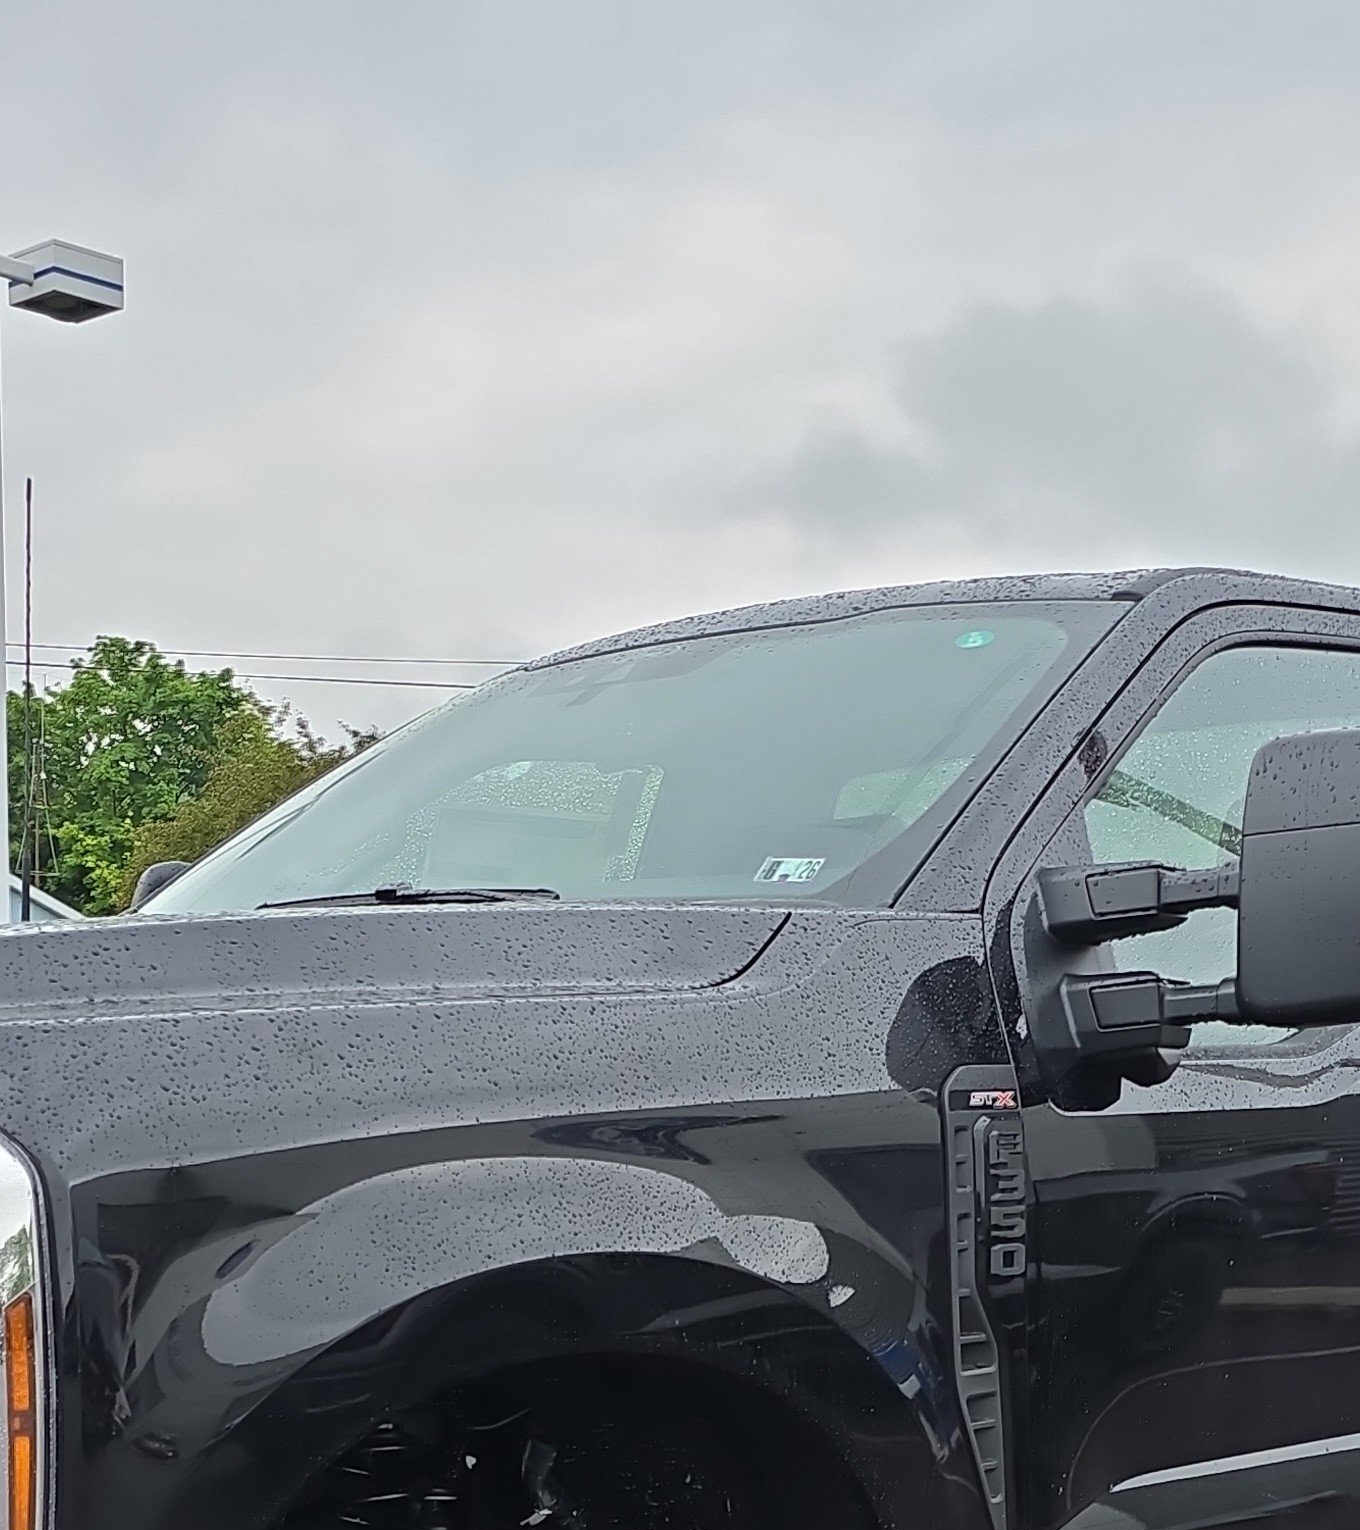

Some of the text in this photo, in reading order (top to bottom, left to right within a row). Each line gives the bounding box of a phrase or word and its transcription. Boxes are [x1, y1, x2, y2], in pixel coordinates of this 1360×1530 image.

[797, 861, 821, 880] 26
[969, 1091, 1017, 1109] STX
[988, 1130, 1026, 1276] F350
